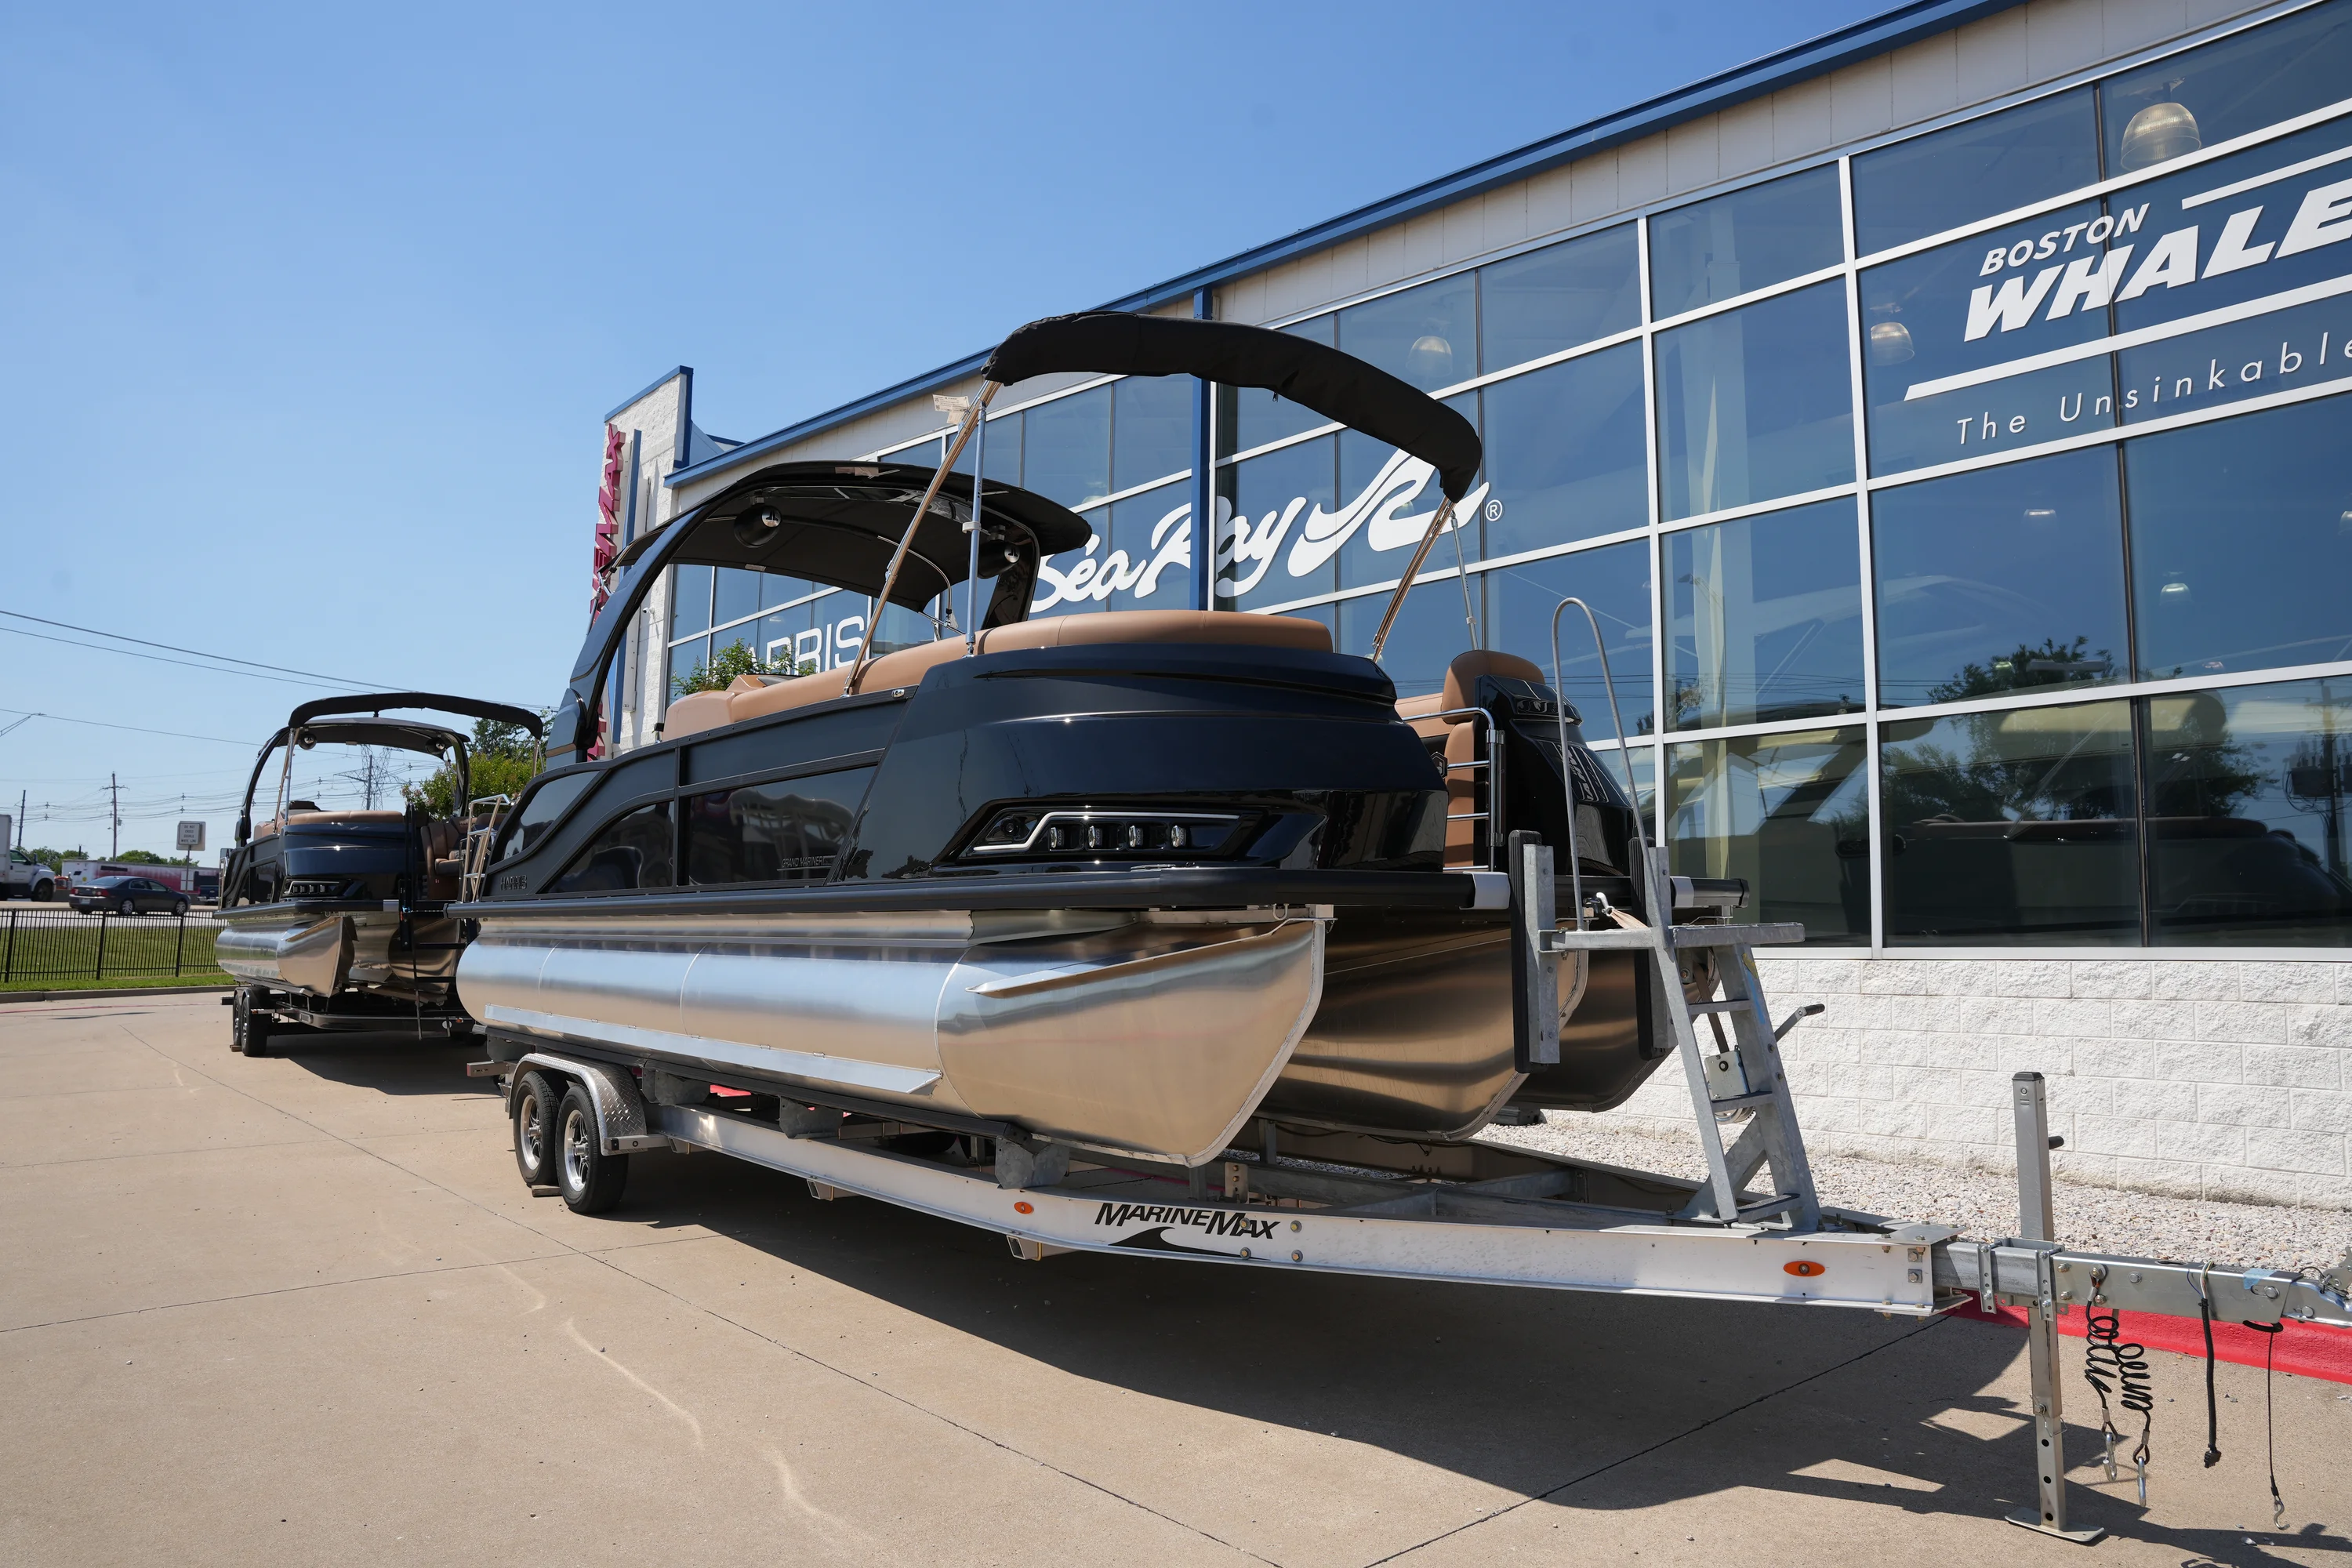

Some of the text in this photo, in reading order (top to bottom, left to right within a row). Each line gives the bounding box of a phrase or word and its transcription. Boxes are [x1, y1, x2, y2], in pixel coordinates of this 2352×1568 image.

[1963, 177, 2352, 343] WHALE
[1979, 202, 2150, 277] BOSTON
[1957, 412, 2027, 445] The
[1134, 495, 1307, 598] Ray
[713, 615, 865, 682] RRIS
[500, 875, 527, 891] HARRIS
[782, 855, 823, 868] GRAND MARINER
